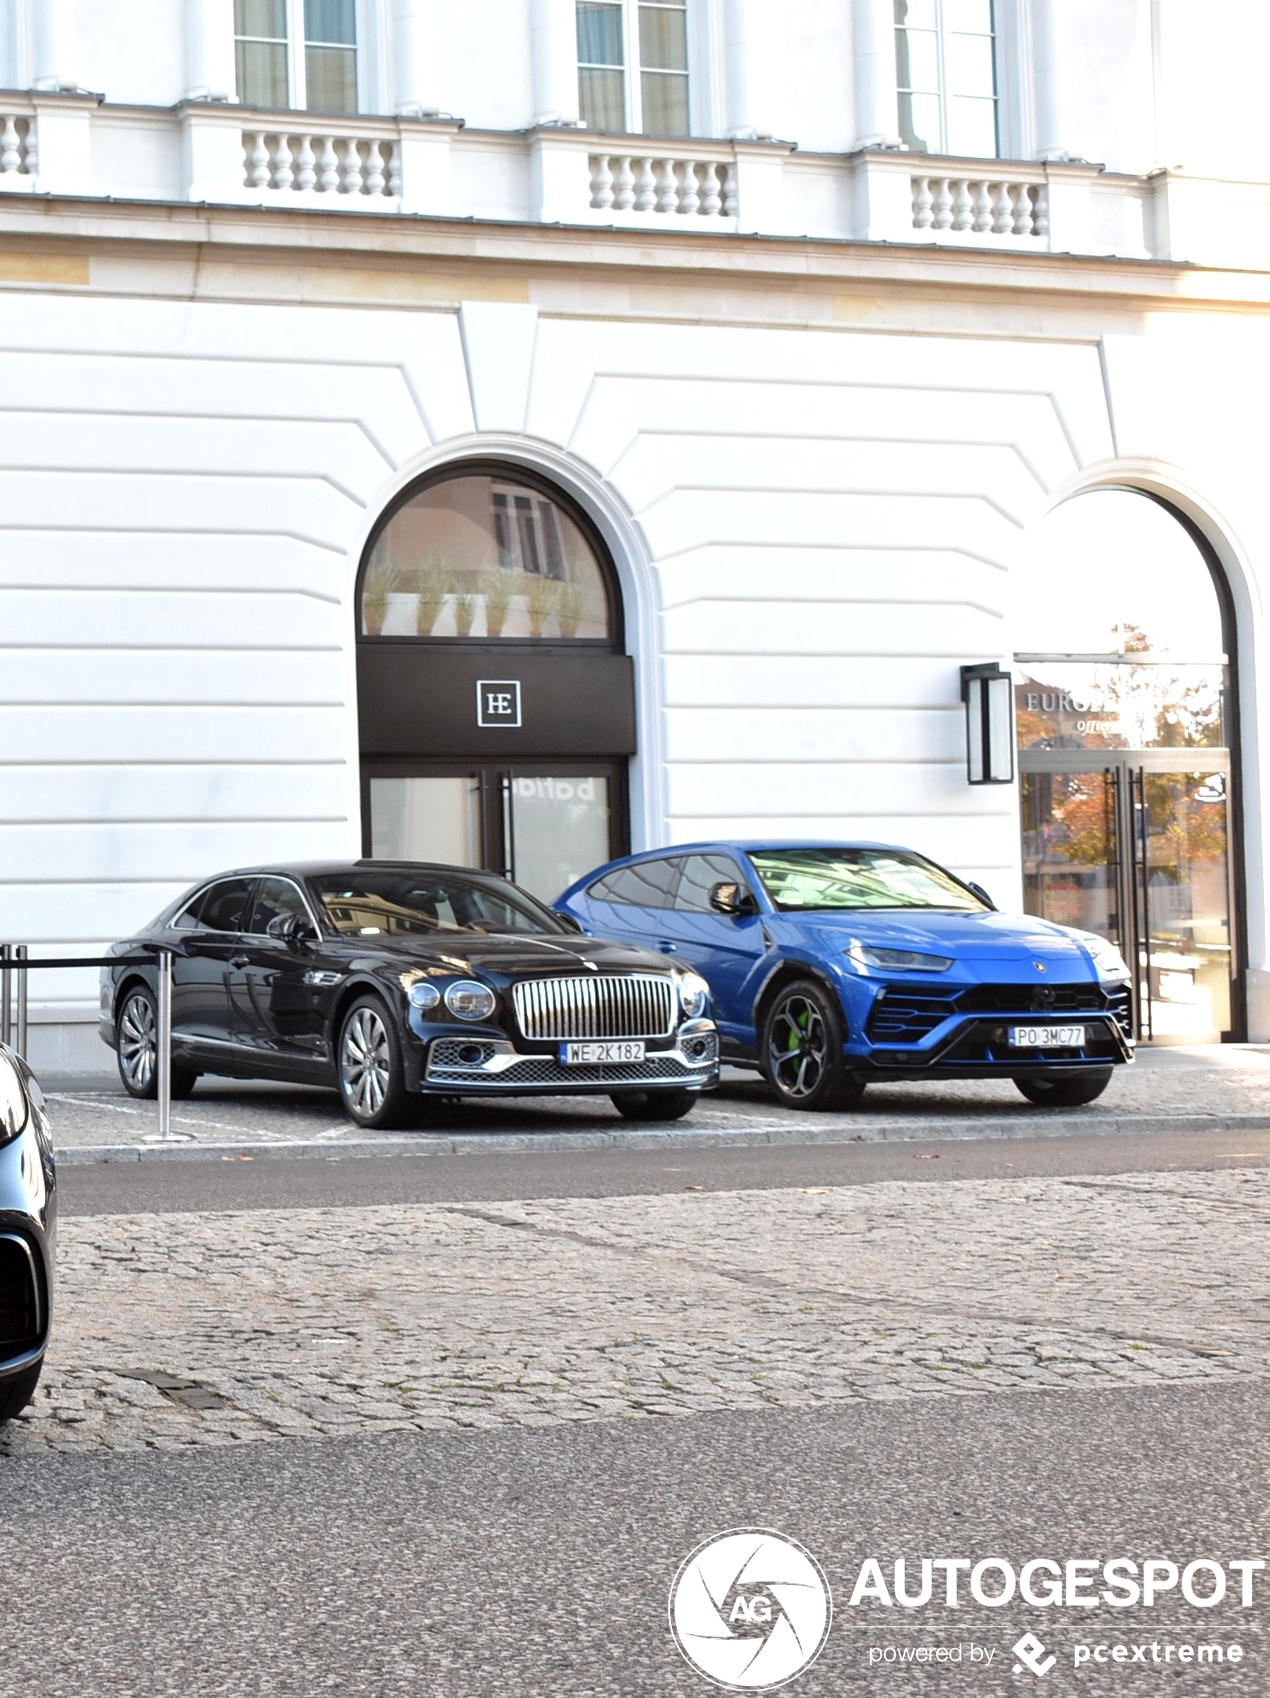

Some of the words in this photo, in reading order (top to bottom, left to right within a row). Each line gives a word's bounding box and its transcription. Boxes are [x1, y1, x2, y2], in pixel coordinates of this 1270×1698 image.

[486, 693, 512, 714] HE
[1018, 1029, 1037, 1044] PO
[1042, 1028, 1082, 1044] 3MC77
[570, 1045, 591, 1061] WE
[596, 1043, 641, 1061] 2K182
